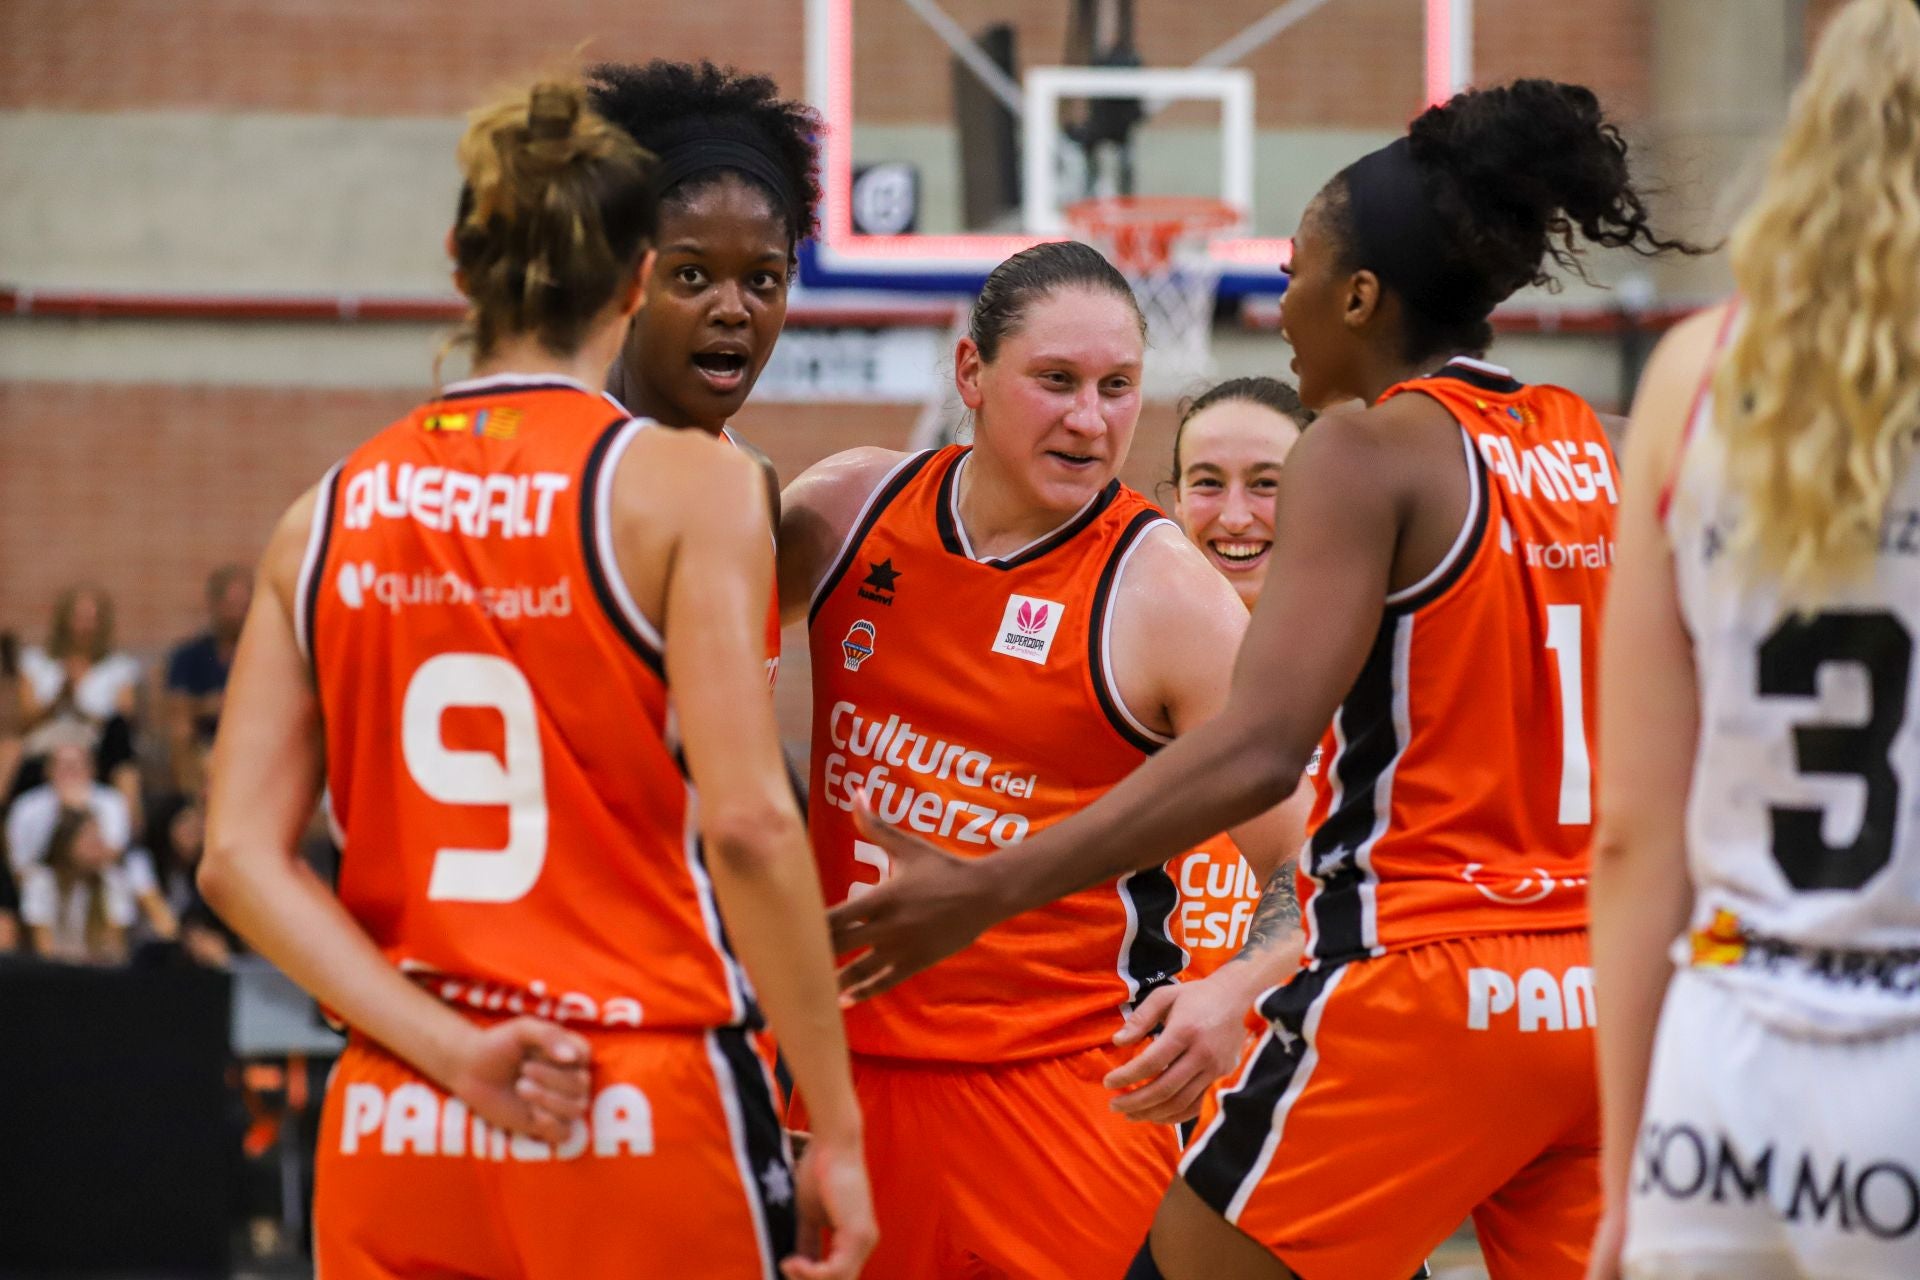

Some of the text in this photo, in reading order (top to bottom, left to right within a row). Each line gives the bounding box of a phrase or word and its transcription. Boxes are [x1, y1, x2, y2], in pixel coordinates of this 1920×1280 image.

[344, 461, 570, 539] QUERALT
[1005, 633, 1045, 651] SUPERCOPA
[830, 700, 1037, 799] Cultura del
[1545, 604, 1591, 825] 1
[1755, 609, 1913, 892] 3
[402, 653, 548, 903] 9
[824, 752, 1030, 849] Esfuerzo
[1181, 901, 1254, 949] Esf
